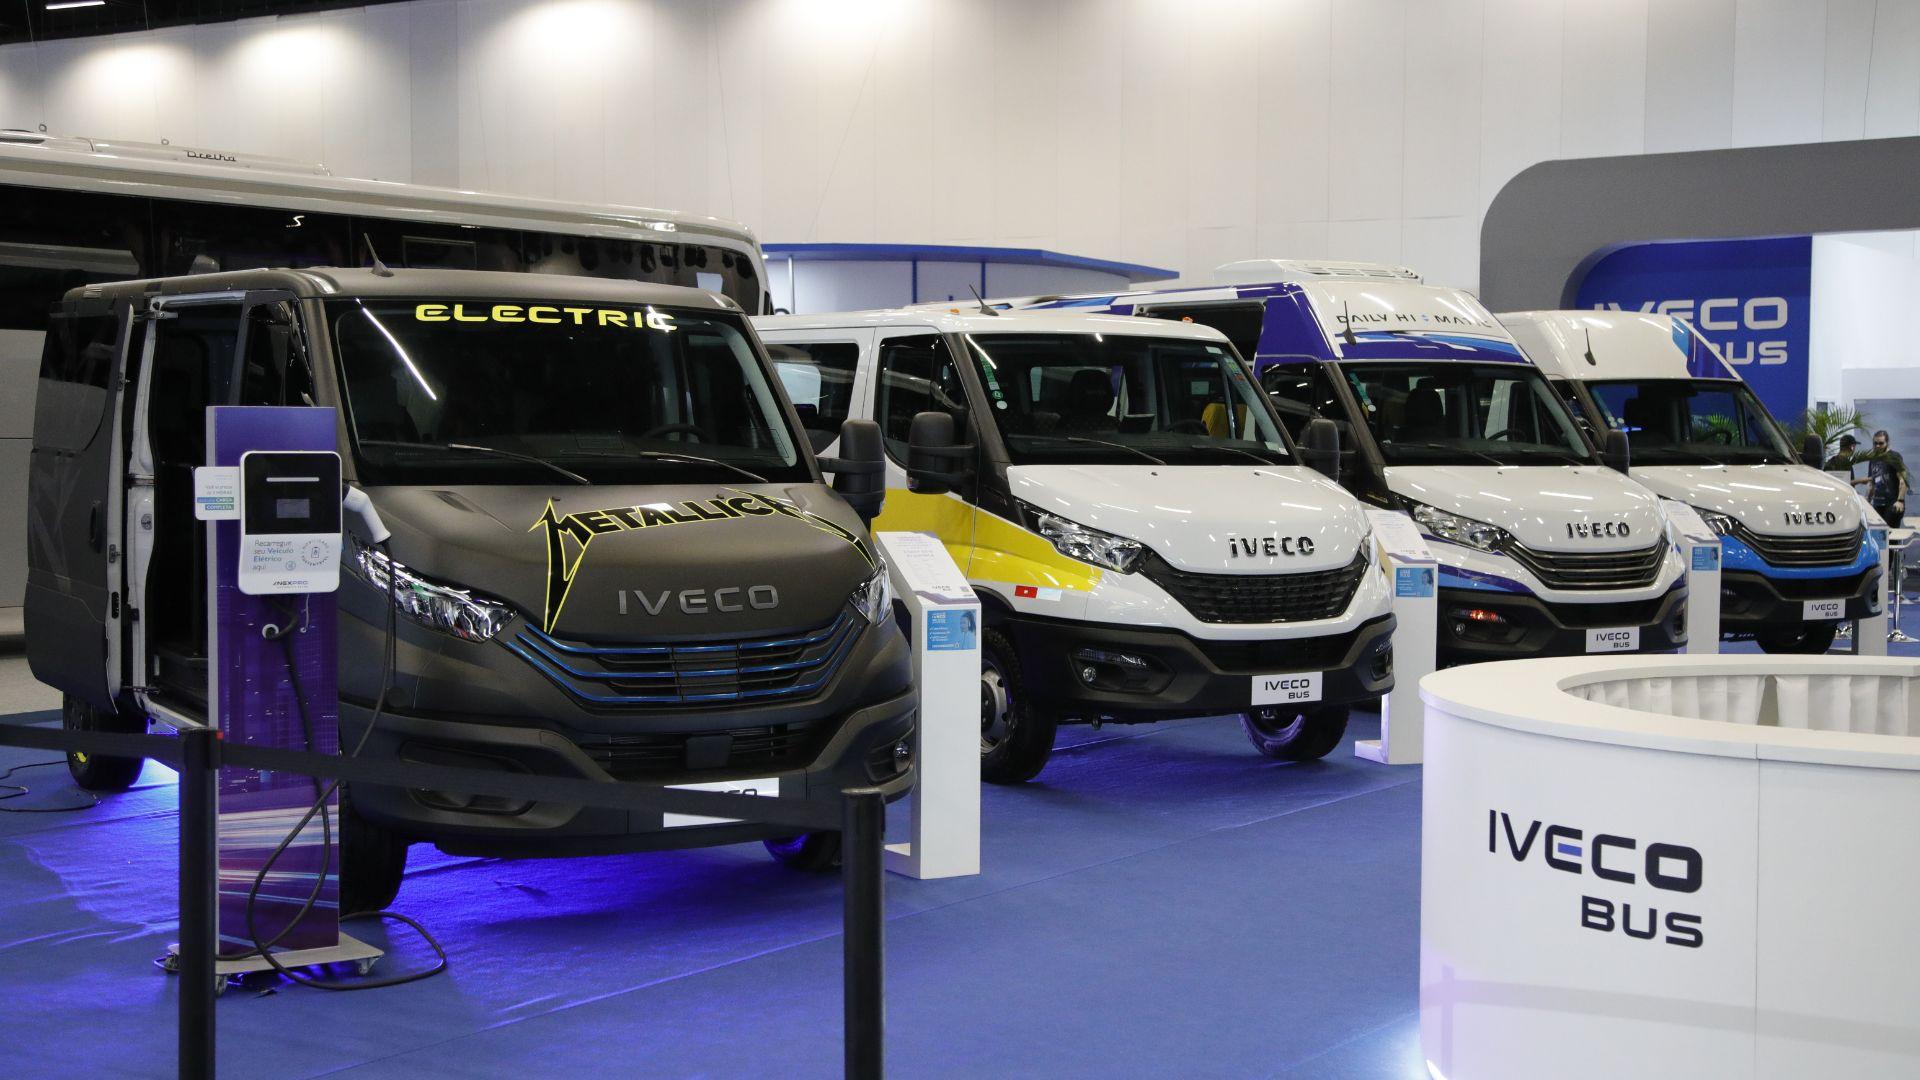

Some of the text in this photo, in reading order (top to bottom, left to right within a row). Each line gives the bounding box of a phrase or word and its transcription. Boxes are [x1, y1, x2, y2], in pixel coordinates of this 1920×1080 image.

[415, 304, 678, 331] ELECTRIC
[1336, 313, 1388, 324] DAILY
[1784, 511, 1836, 526] IVECO
[1566, 522, 1631, 539] IVECO
[1229, 536, 1315, 558] IVECO
[528, 487, 876, 634] METALLICA
[617, 585, 779, 616] IVECO
[1596, 632, 1630, 641] IVECO
[1265, 679, 1310, 691] IVECO
[1288, 691, 1310, 699] BUS
[1489, 809, 1703, 893] IVECO
[1581, 895, 1703, 948] BUS
